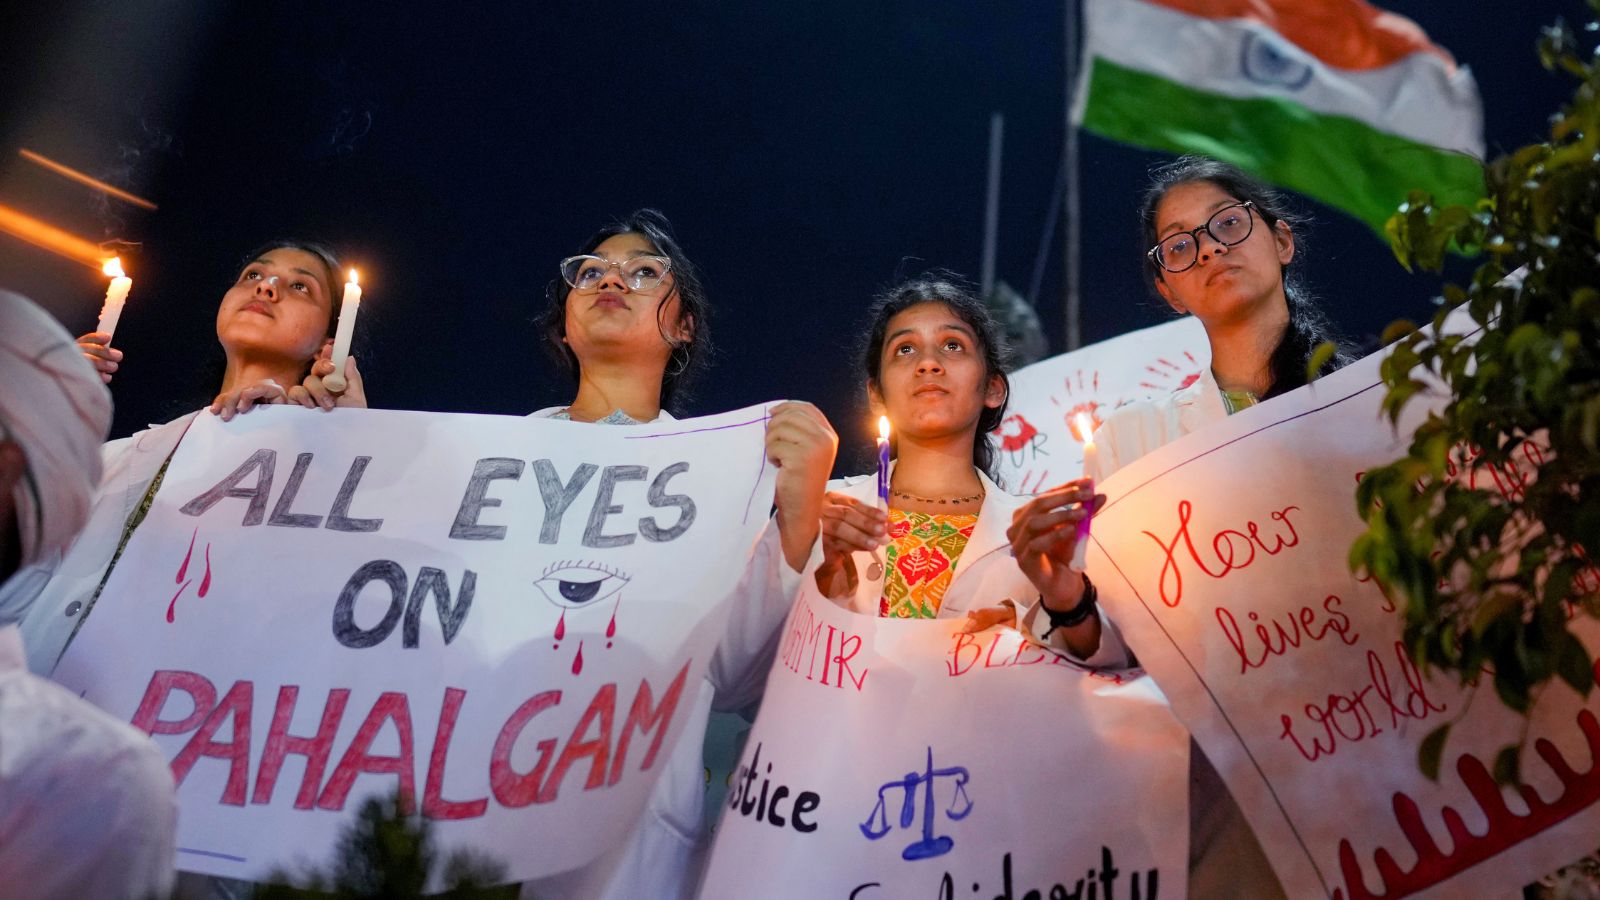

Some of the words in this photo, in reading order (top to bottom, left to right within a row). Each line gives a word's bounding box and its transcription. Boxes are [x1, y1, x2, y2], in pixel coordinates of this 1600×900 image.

[180, 448, 384, 532] ALL
[449, 456, 697, 547] EYES
[332, 559, 478, 649] ON
[1140, 500, 1300, 608] How
[1215, 595, 1360, 674] lives
[130, 659, 692, 820] PAHALGAM
[1280, 640, 1447, 761] world
